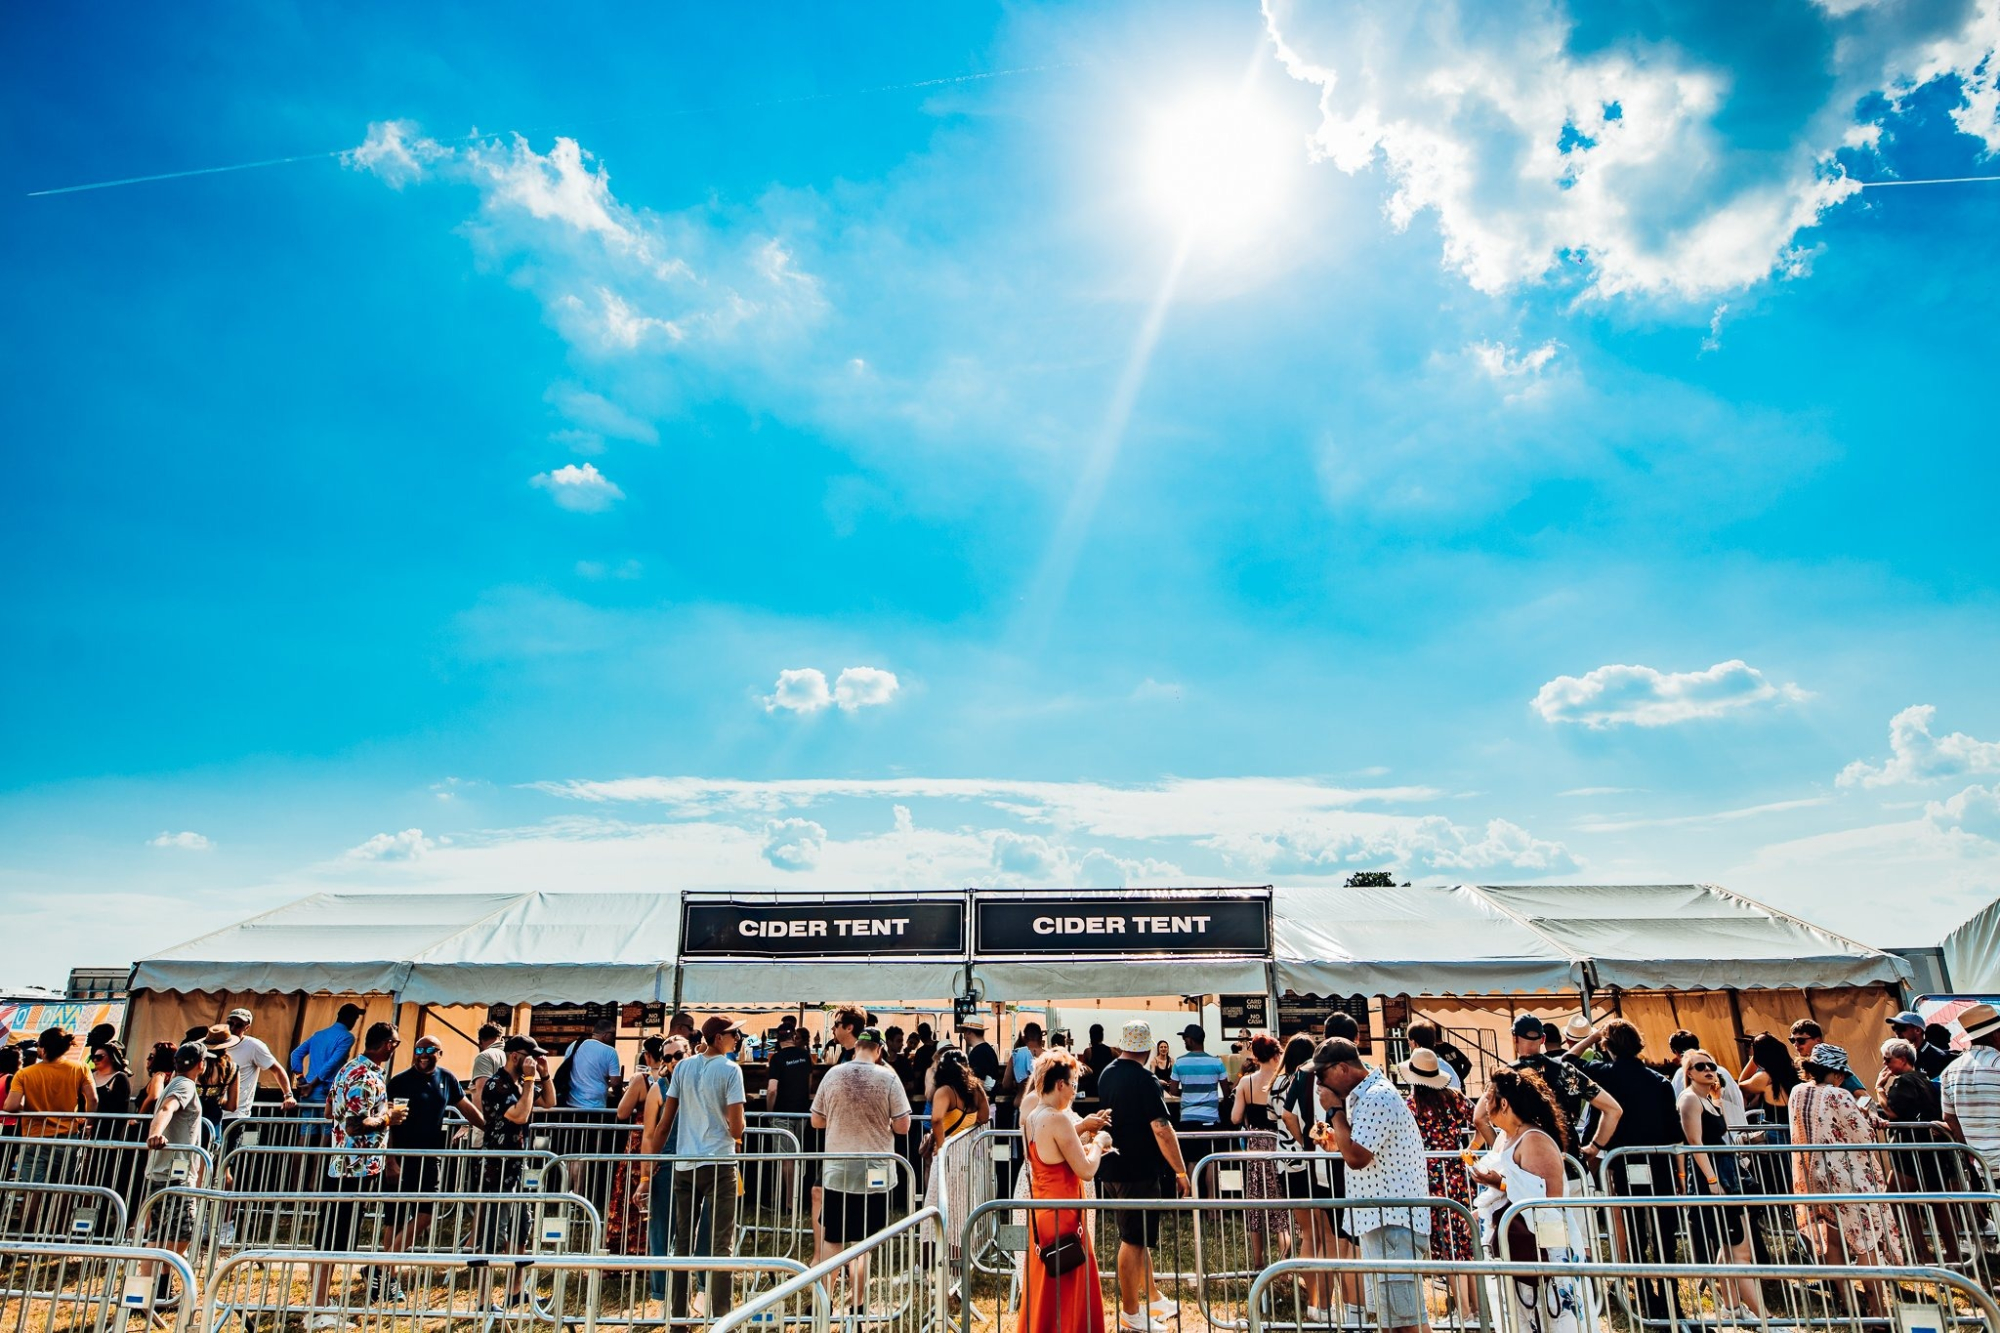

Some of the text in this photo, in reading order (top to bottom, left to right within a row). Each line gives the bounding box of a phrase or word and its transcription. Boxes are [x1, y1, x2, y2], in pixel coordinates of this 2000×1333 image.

[738, 918, 910, 938] CIDER TENT
[1032, 916, 1211, 935] CIDER TENT
